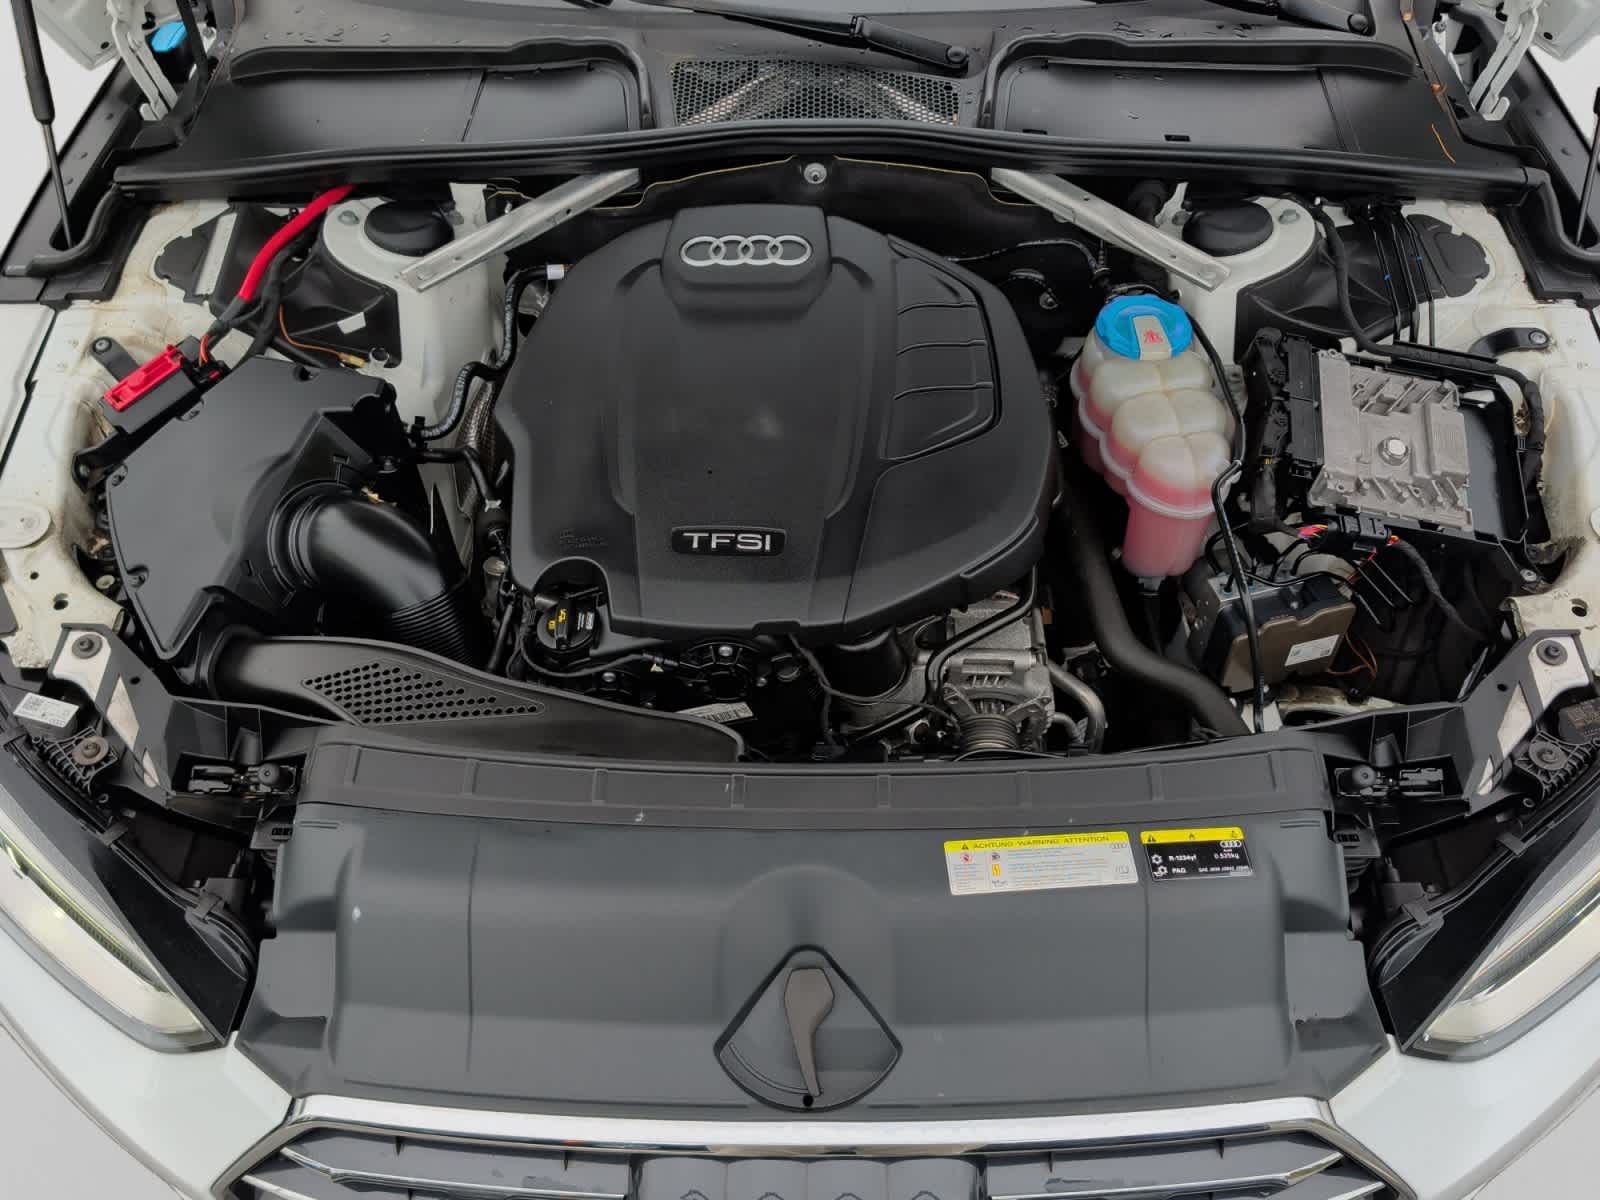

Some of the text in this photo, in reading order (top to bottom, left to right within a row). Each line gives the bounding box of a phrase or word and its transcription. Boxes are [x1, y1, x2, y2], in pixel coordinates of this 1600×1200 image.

[682, 532, 771, 551] TFSI
[973, 836, 1110, 850] ACHTUNG WARNING ATTENTION
